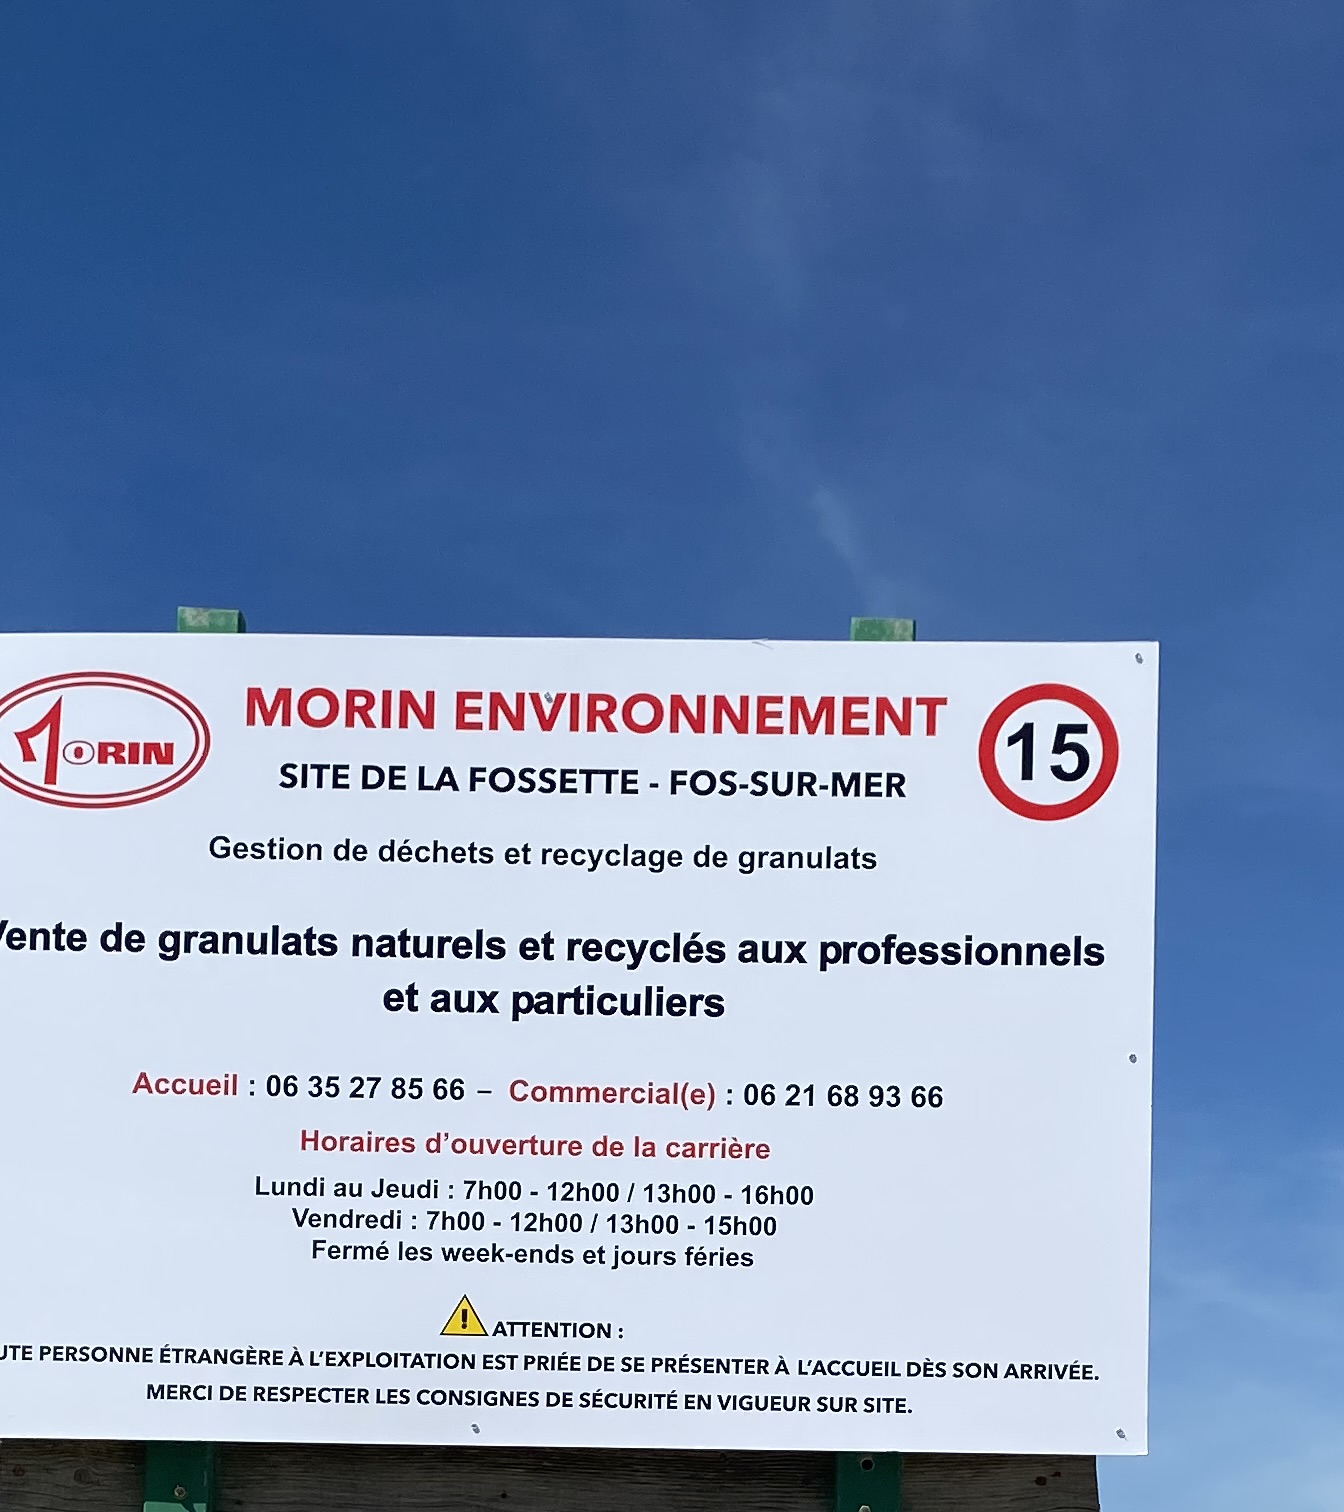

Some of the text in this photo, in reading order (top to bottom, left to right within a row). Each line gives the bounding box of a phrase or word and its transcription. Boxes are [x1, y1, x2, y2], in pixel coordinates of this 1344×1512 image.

[246, 686, 948, 737] MORIN ENVIRONNEMENT
[1006, 721, 1091, 782] 15
[278, 762, 350, 790] SITE
[361, 764, 407, 791] DE
[417, 765, 460, 792] LA
[469, 766, 639, 795] FOSSETTE
[670, 769, 907, 798] FOS-SUR-MER
[209, 835, 877, 875] Gestion de déchets et recyclage de granulats
[99, 921, 146, 953] de
[158, 924, 339, 962] granulats
[351, 927, 507, 961] naturels
[518, 930, 555, 962] et
[566, 931, 726, 971] recyclés
[737, 939, 808, 964] aux
[819, 933, 1105, 973] professionnels
[382, 981, 725, 1022] et aux particuliers
[131, 1071, 238, 1096] Accueil
[266, 1074, 299, 1098] 06
[307, 1075, 341, 1099] 35
[348, 1075, 382, 1099] 27
[391, 1076, 424, 1100] 85
[432, 1077, 465, 1101] 66
[509, 1079, 715, 1112] Commercial(e)
[743, 1083, 776, 1107] 06
[784, 1083, 814, 1107] 21
[827, 1084, 859, 1108] 68
[868, 1084, 901, 1108] 93
[910, 1085, 944, 1109] 66
[301, 1129, 416, 1154] Horaires
[592, 1135, 625, 1157] de
[634, 1135, 656, 1158] la
[665, 1136, 771, 1160] carrière
[255, 1175, 325, 1197] Lundi
[333, 1182, 363, 1198] au
[370, 1177, 439, 1199] Jeudi
[463, 1179, 522, 1201] 7h00
[547, 1181, 620, 1203] 12h00
[643, 1183, 716, 1205] 13h00
[741, 1184, 814, 1206] 16h00
[291, 1207, 402, 1230] Vendredi
[426, 1210, 485, 1232] 7h00
[510, 1211, 583, 1233] 12h00
[606, 1213, 679, 1235] 13h00
[704, 1215, 777, 1237] 15h00
[312, 1239, 754, 1270] Fermé les week-ends et jours féries
[491, 1320, 612, 1339] ATTENTION
[39, 1345, 154, 1364] PERSONNE
[159, 1343, 284, 1366] ÉTRANGÈRE
[287, 1345, 305, 1367] À
[482, 1354, 519, 1371] EST
[523, 1351, 582, 1372] PRIÉE
[587, 1355, 615, 1373] DE
[620, 1356, 645, 1373] SE
[651, 1353, 770, 1375] PRÉSENTER
[774, 1354, 791, 1376] À
[906, 1357, 947, 1378] DÈS
[951, 1361, 999, 1379] SON
[1003, 1359, 1100, 1381] ARRIVÉE.
[146, 1383, 913, 1414] MERCI DE RESPECTER LES CONSIGNES DE SÉCURITÉ EN VIGUEUR SUR SITE.
